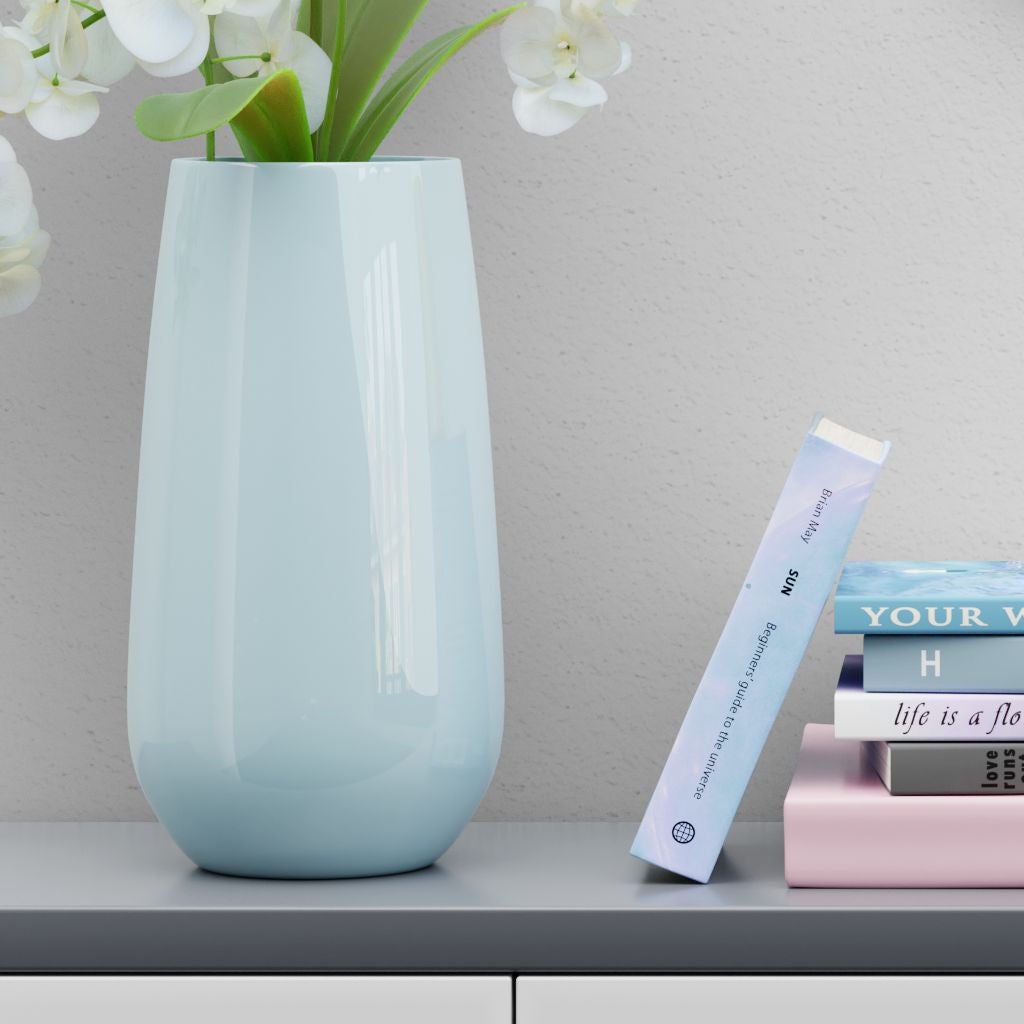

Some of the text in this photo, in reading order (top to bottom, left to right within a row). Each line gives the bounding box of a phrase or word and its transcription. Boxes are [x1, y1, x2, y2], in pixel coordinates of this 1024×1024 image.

[800, 488, 833, 544] Brian May
[780, 568, 799, 596] SUN
[861, 606, 989, 627] YOUR
[729, 681, 749, 714] guide
[723, 716, 735, 728] to
[894, 702, 930, 735] life
[940, 706, 959, 726] is
[968, 710, 984, 726] a
[714, 731, 729, 750] the
[693, 752, 719, 800] universe
[980, 750, 999, 788] love
[1003, 748, 1016, 790] runs
